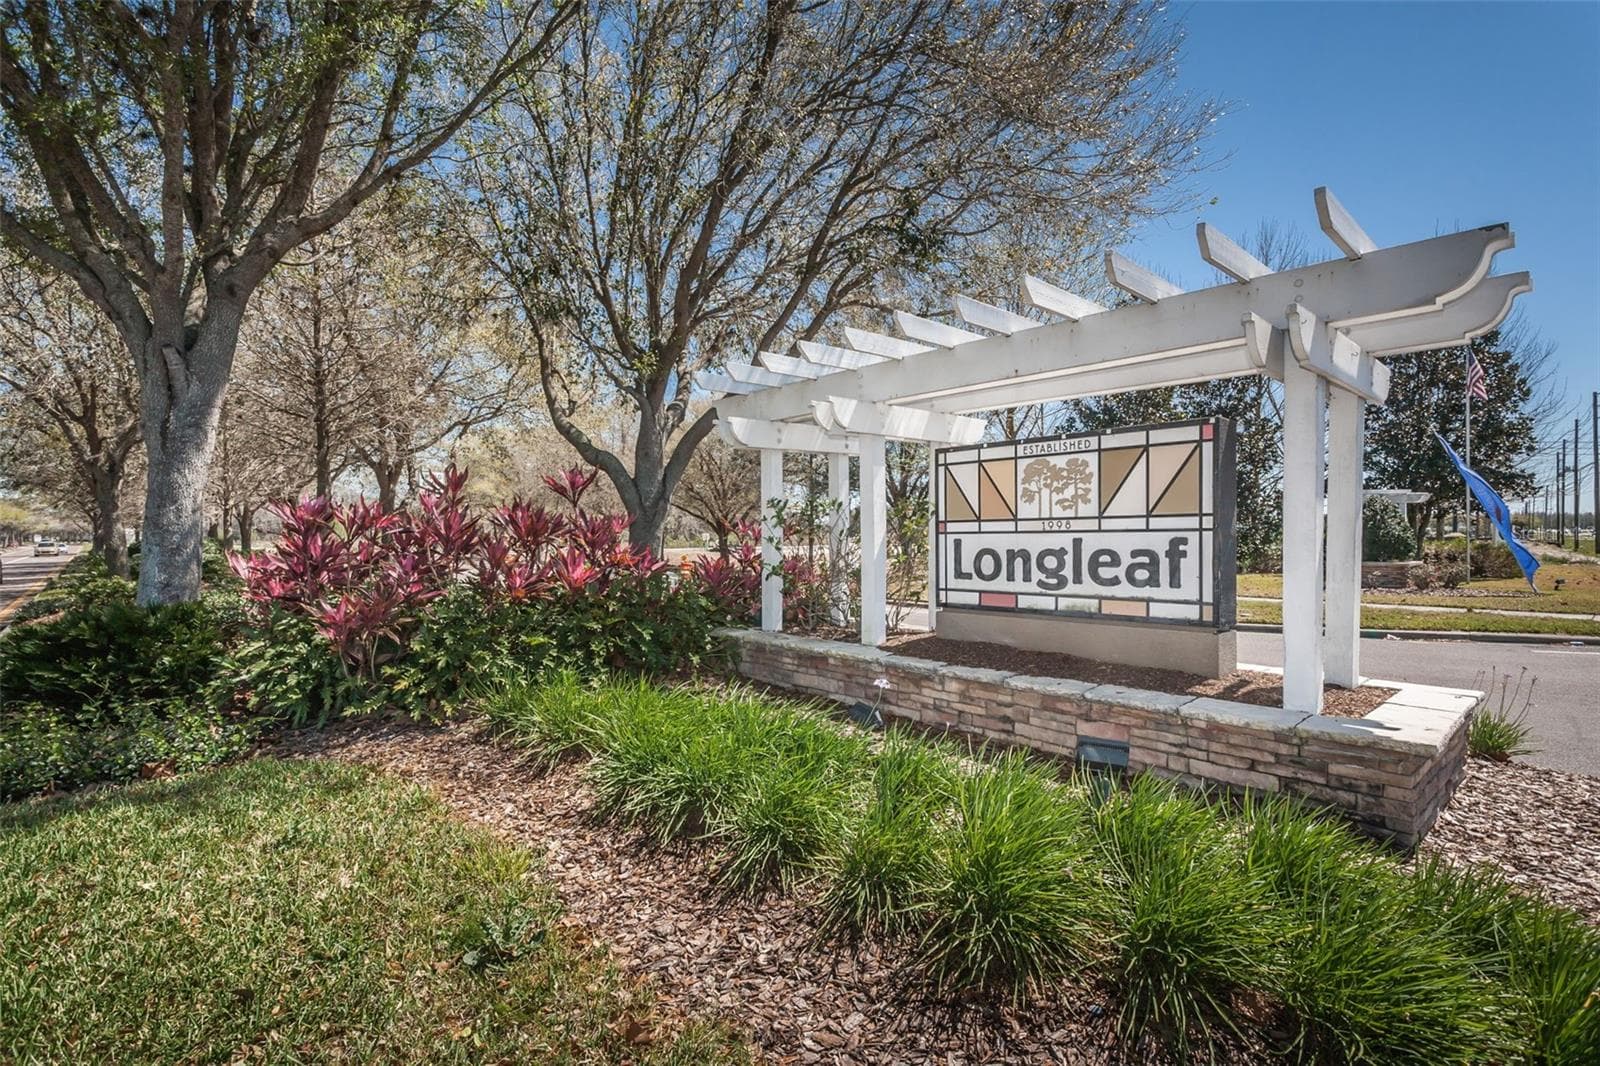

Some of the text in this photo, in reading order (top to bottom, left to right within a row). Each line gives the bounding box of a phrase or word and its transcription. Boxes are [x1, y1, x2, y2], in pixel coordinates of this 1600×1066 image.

[1023, 439, 1091, 455] ESTABLISHED
[1042, 520, 1072, 531] 1998
[953, 536, 1189, 591] Longleaf
